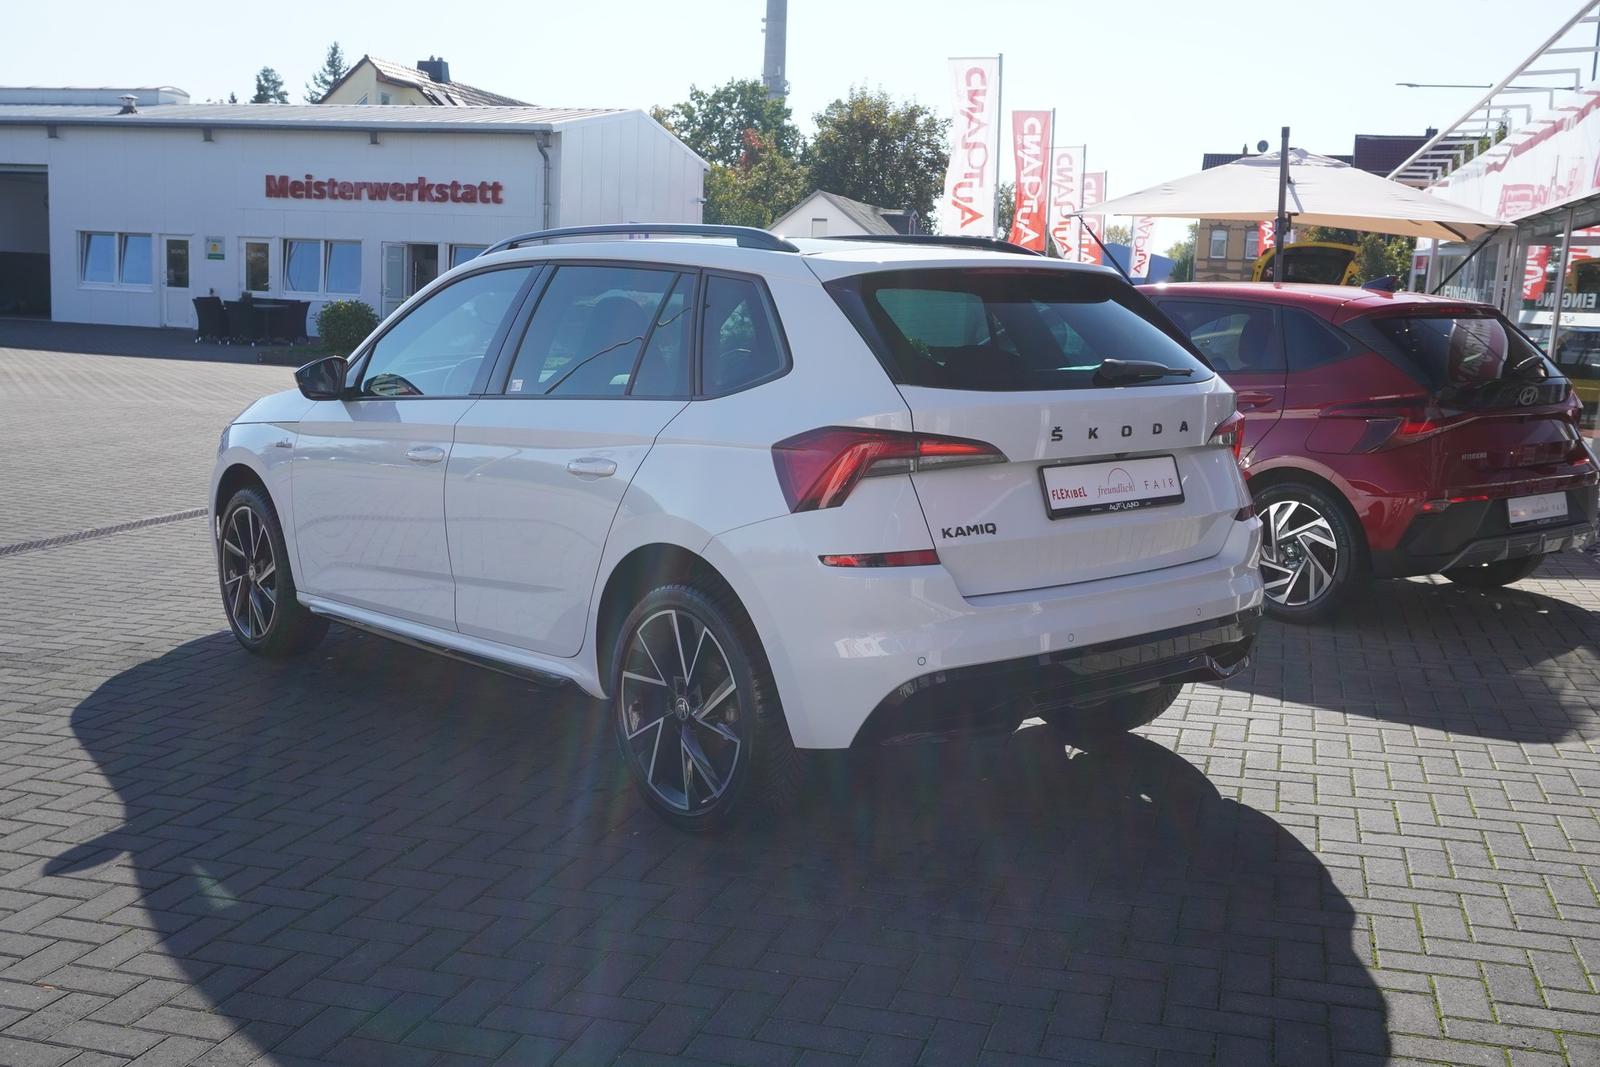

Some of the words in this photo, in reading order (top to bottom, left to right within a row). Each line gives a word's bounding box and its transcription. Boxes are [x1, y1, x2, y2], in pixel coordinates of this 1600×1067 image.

[265, 174, 503, 204] Meisterwerkstatt
[1133, 216, 1153, 273] AUTOLAN
[1051, 421, 1189, 441] ŠKODA
[1051, 486, 1087, 500] FLEXIBEL
[1144, 478, 1174, 489] FAIR
[941, 522, 997, 539] KAMIQ
